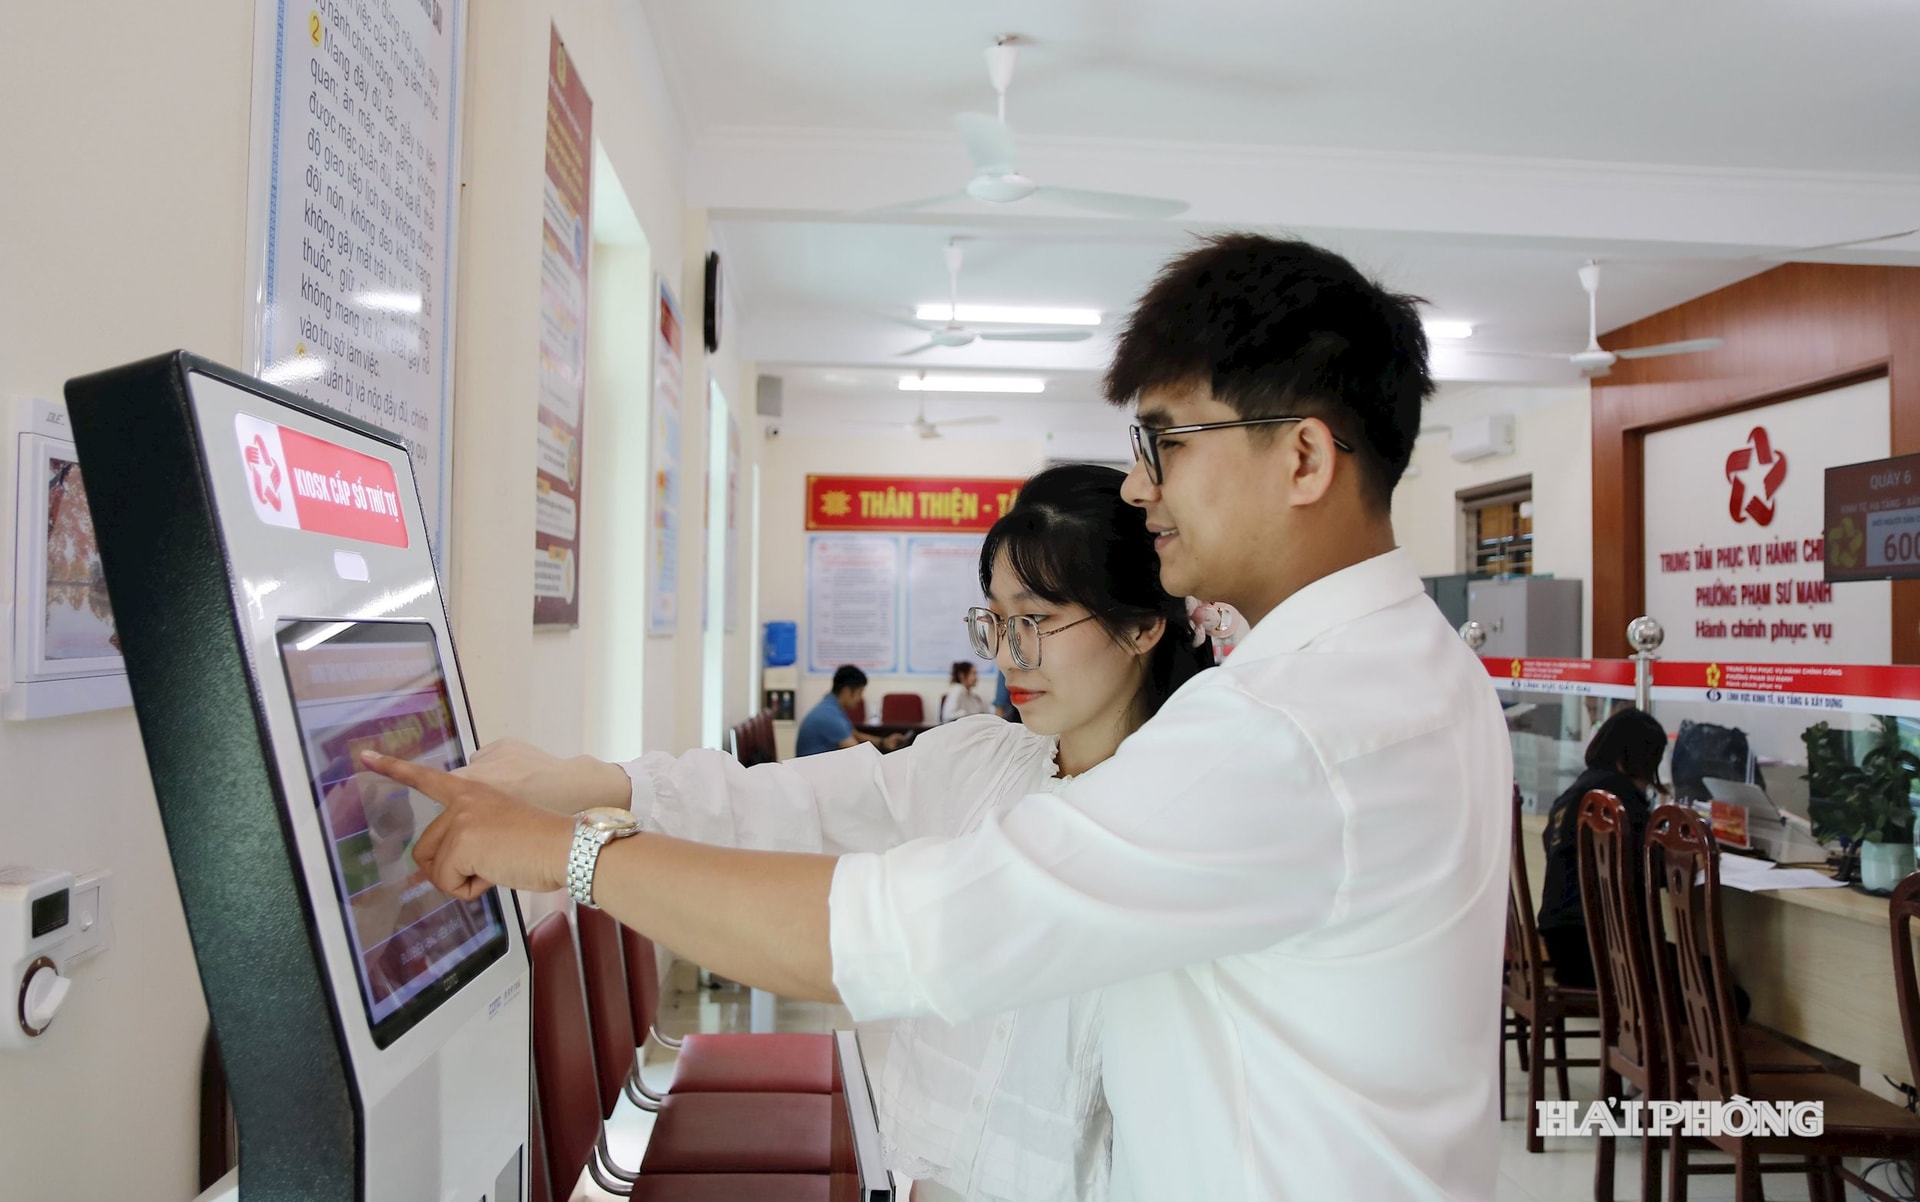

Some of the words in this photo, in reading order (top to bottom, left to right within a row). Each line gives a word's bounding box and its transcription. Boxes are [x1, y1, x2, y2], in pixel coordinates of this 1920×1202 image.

[311, 14, 320, 43] 2
[323, 25, 350, 83] Mang
[353, 61, 369, 103] đầy
[372, 84, 382, 113] đủ
[385, 103, 398, 132] các
[351, 27, 374, 70] chính
[373, 21, 387, 54] của
[389, 37, 409, 88] Trung
[309, 89, 336, 136] được
[338, 120, 357, 157] mặc
[310, 56, 339, 103] quan;
[343, 87, 354, 117] ăn
[358, 106, 375, 141] mặc
[307, 126, 321, 162] độ
[324, 142, 344, 180] giao
[347, 159, 363, 199] tiếp
[365, 178, 379, 212] lịch
[304, 197, 335, 250] không
[337, 227, 354, 263] gây
[356, 239, 373, 272] mất
[305, 163, 322, 199] đội
[326, 182, 346, 218] nón,
[350, 199, 376, 247] không
[379, 226, 393, 256] đeo
[302, 234, 334, 281] thuốc,
[339, 265, 355, 295] giữ
[301, 272, 332, 321] không
[335, 300, 360, 337] mang
[299, 312, 319, 344] vào
[319, 323, 332, 356] trụ
[333, 334, 345, 358] sở
[346, 343, 362, 367] làm
[363, 350, 381, 379] việc.
[345, 372, 354, 398] bị
[355, 379, 365, 403] và
[367, 385, 382, 412] nộp
[293, 467, 332, 502] KIOSK
[329, 470, 351, 507] CẤP
[352, 476, 368, 510] SỐ
[365, 485, 386, 515] THỨ
[384, 491, 399, 523] TỰ
[859, 486, 914, 519] THÂN
[918, 487, 979, 525] THIỆN
[1904, 470, 1912, 485] 6
[1660, 552, 1690, 573] TRUNG
[1694, 544, 1713, 570] TÂM
[1717, 545, 1744, 573] PHỤC
[1747, 544, 1762, 572] VỤ
[1766, 535, 1797, 565] HÀNH
[1696, 578, 1737, 607] PHƯỜNG
[1741, 583, 1771, 610] PHẠM
[1796, 581, 1832, 610] MẠNH
[1695, 617, 1727, 638] Hành
[1731, 618, 1766, 638] chính
[1771, 618, 1807, 644] phục
[1813, 623, 1832, 645] vụ
